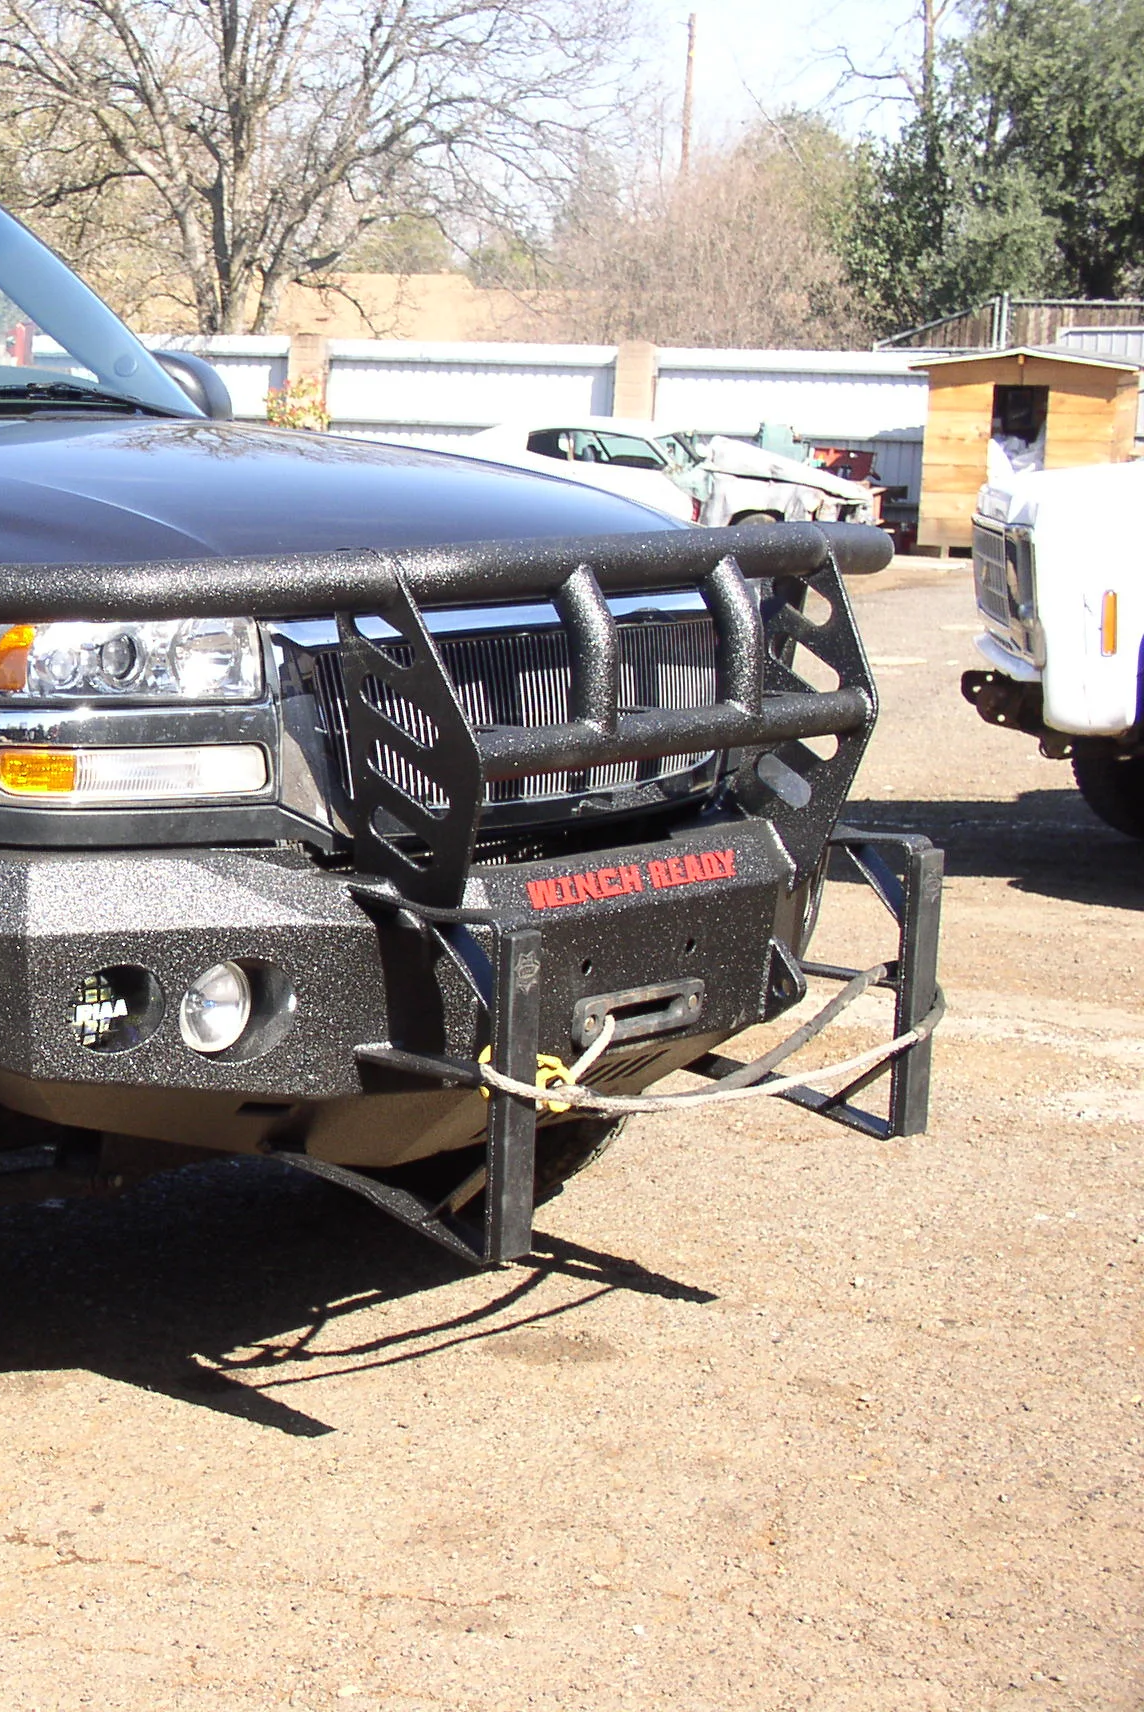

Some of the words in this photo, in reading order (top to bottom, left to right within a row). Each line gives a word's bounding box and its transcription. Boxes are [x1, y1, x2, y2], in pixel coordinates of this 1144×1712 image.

[526, 864, 643, 911] WINCH
[647, 849, 737, 889] READY
[75, 998, 128, 1023] PIAA
